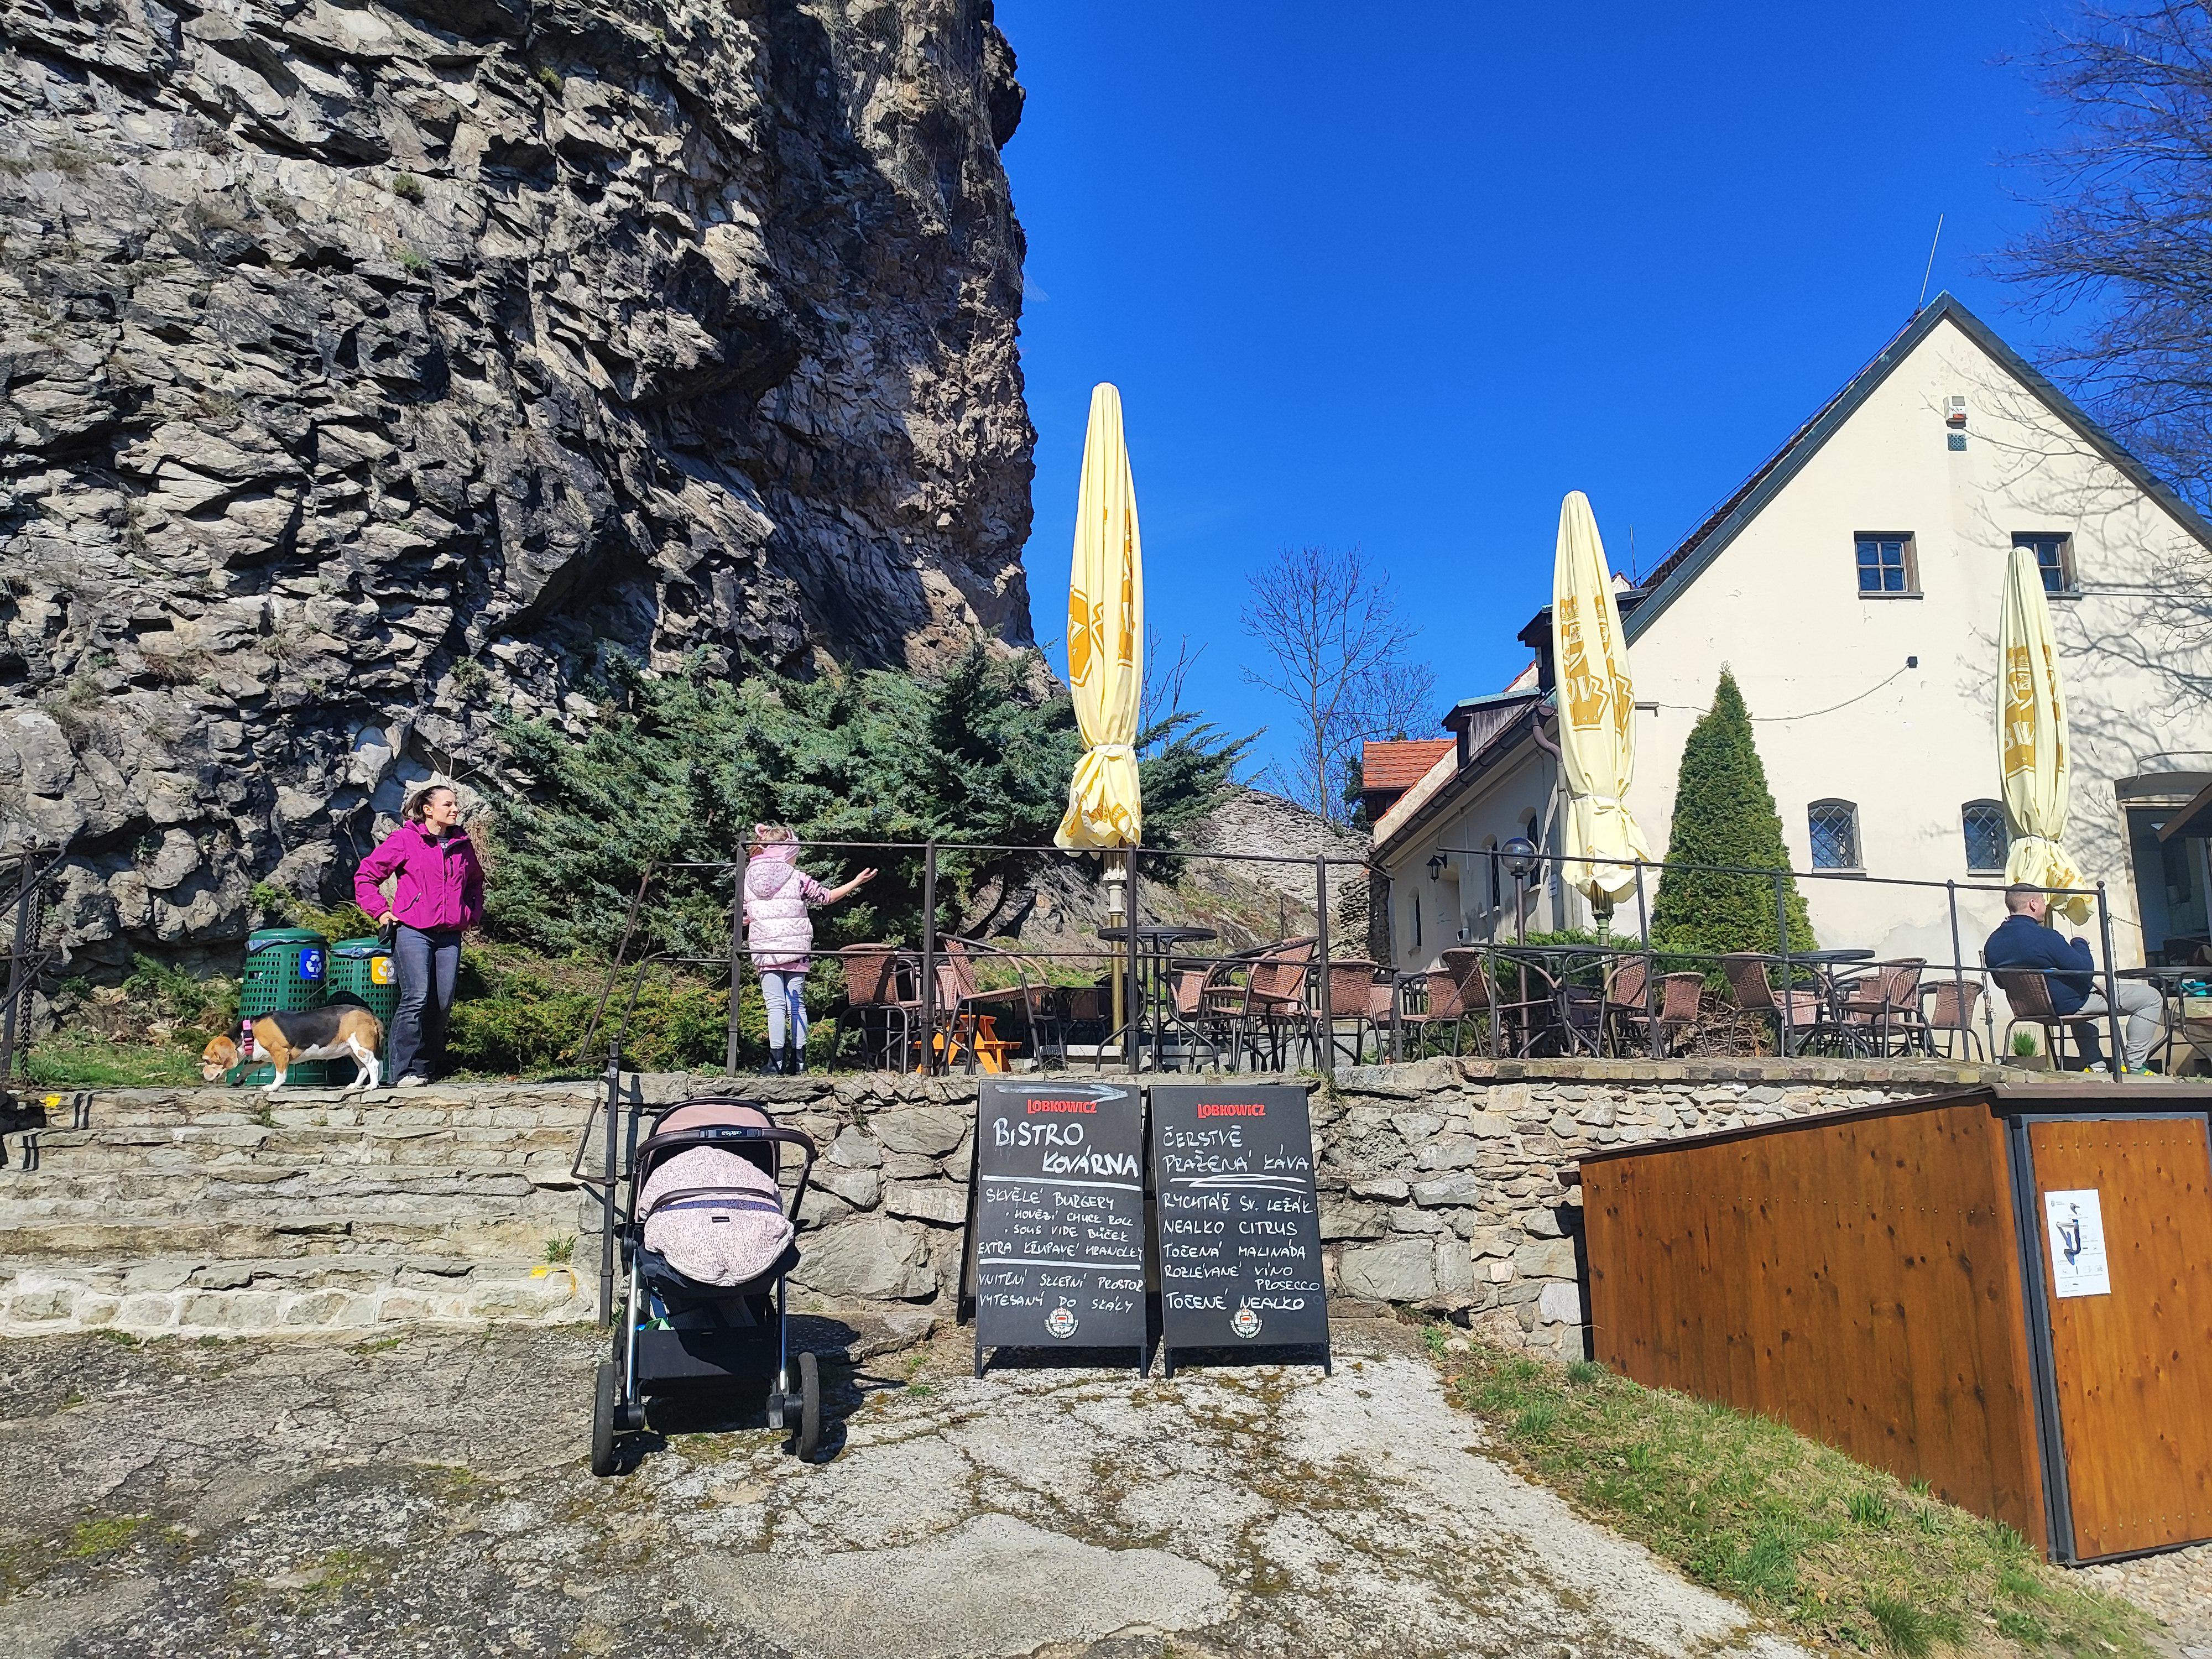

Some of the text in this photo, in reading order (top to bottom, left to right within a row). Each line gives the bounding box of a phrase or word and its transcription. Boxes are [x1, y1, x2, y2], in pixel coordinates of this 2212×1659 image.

[1027, 1098, 1097, 1114] LOBKOWICZ
[1197, 1104, 1266, 1119] LOBKOWICZ
[1042, 1144, 1139, 1178] KOVÁRNA
[1162, 1144, 1310, 1173] PRAŽENÁ KÁVA
[986, 1187, 1114, 1211] SKVĚLÉ BURGERY
[1066, 1212, 1102, 1224] CHUCK
[1108, 1215, 1134, 1227] ROLL
[1163, 1219, 1298, 1236] NEALKO CITRUS
[1014, 1224, 1042, 1235] SOUS
[1051, 1225, 1078, 1238] VIDE
[978, 1241, 1013, 1255] EXTRA
[1085, 1245, 1143, 1262] HRANOLKY
[1238, 1239, 1306, 1260] MALINÁDA
[1254, 1262, 1293, 1276] VÍNO
[1039, 1272, 1087, 1288] SKLEPNÍ
[1098, 1276, 1144, 1292] PROSTOR
[1255, 1279, 1321, 1291] PROSECCO
[1058, 1296, 1077, 1307] DO
[1091, 1296, 1134, 1313] SKÁLY
[1240, 1296, 1305, 1311] NEALKO
